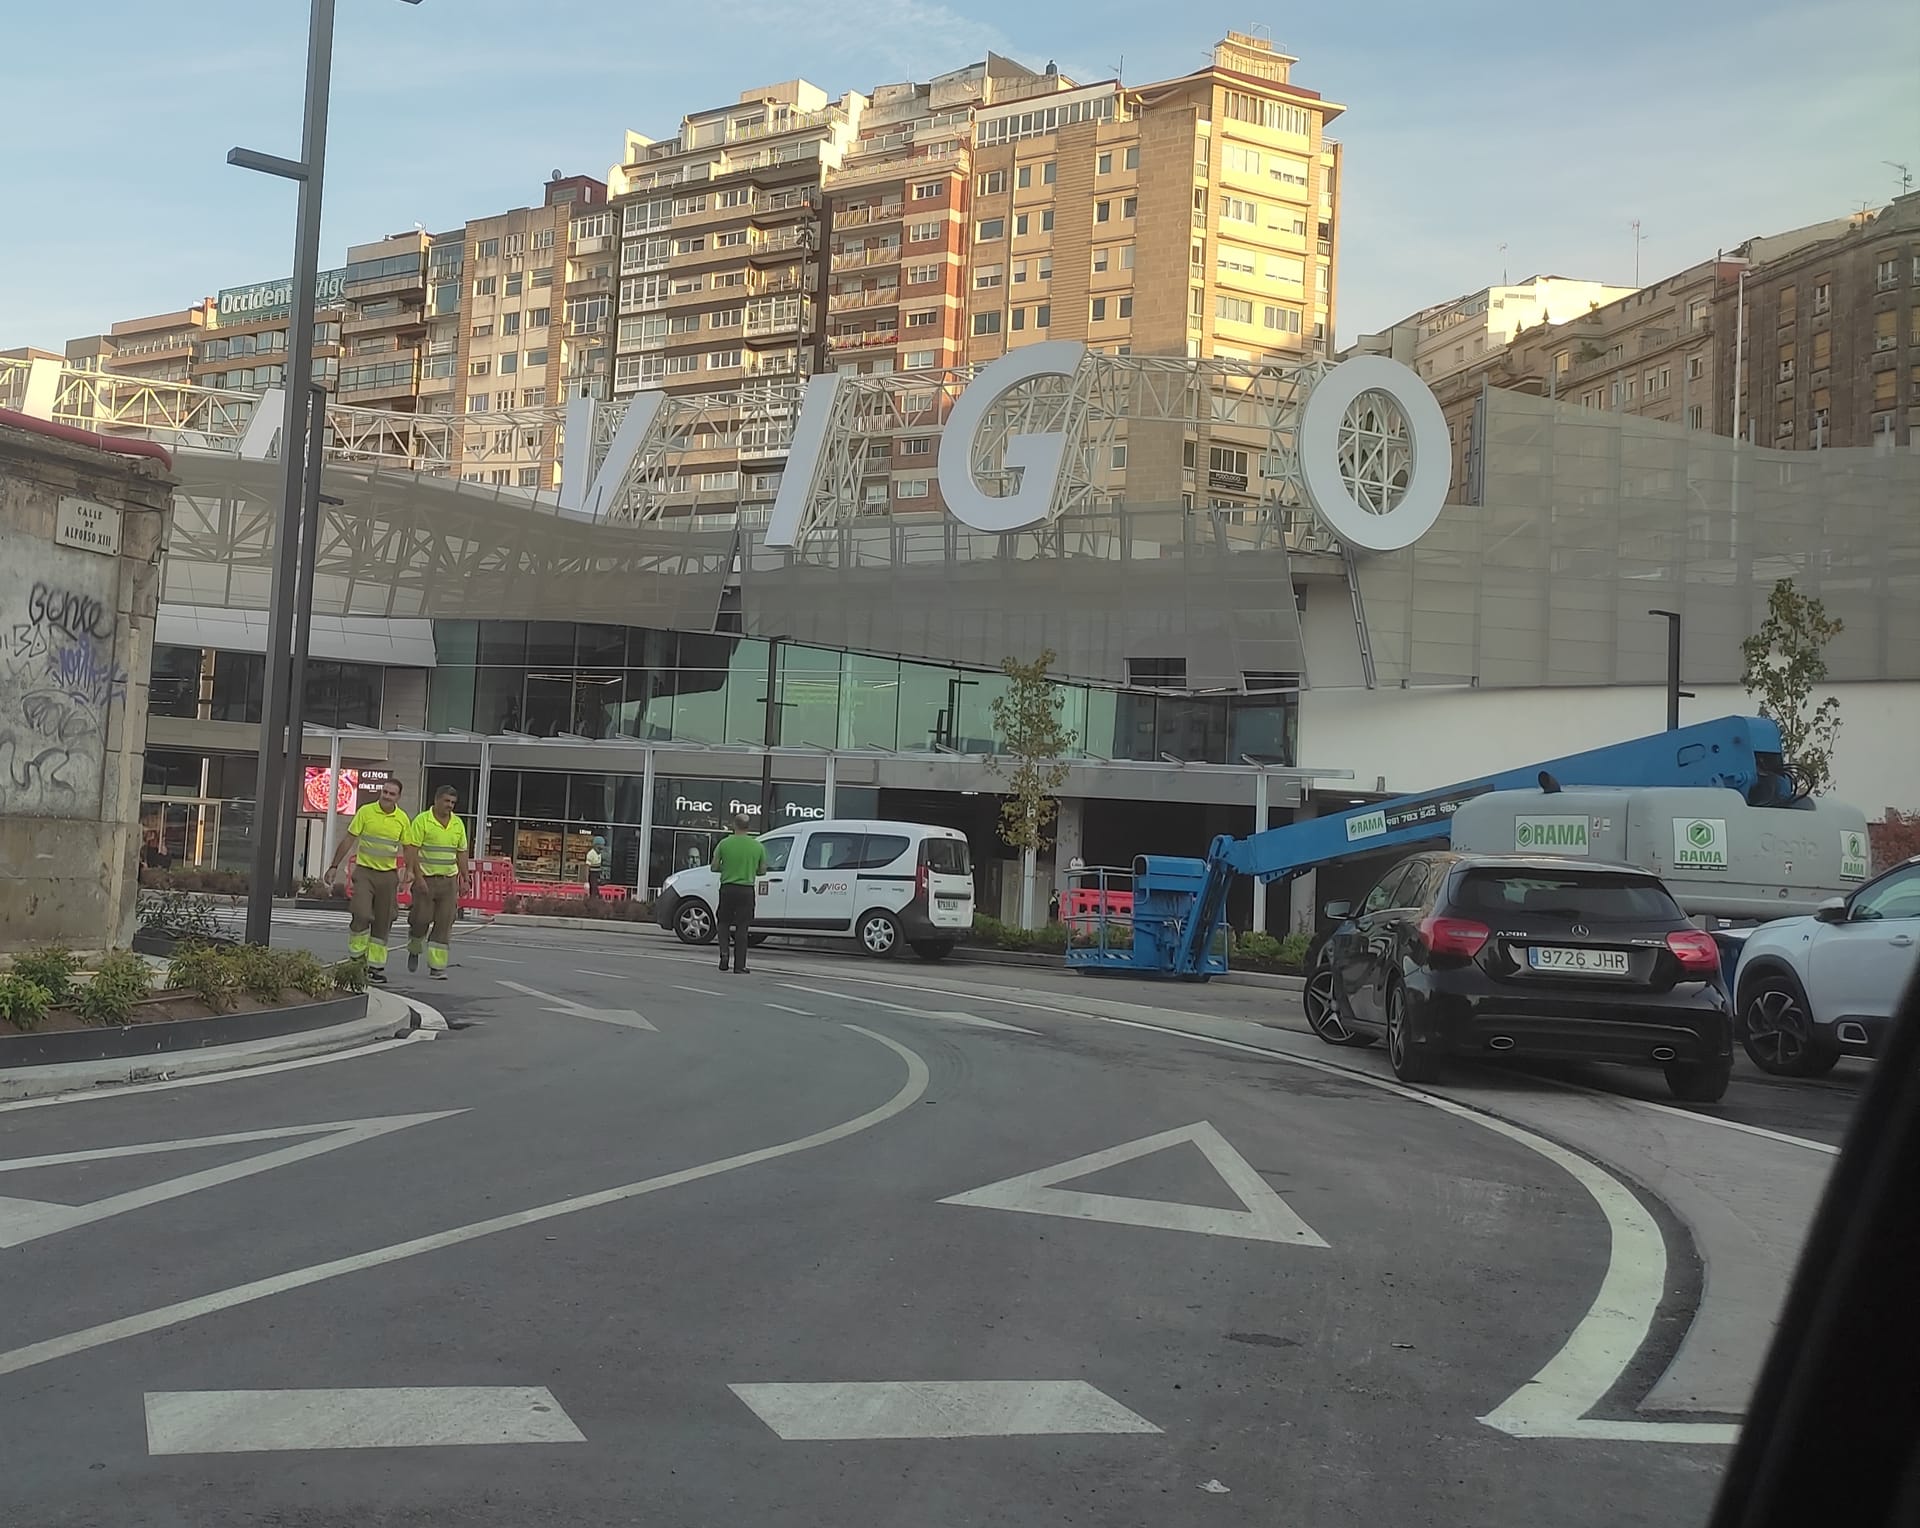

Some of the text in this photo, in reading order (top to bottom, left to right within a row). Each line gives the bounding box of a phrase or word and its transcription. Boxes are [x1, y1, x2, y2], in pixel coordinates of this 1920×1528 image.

[559, 340, 1452, 551] VIGO
[77, 506, 103, 520] CALLE
[84, 520, 94, 529] DE
[65, 526, 111, 546] ALFONSO XIII
[361, 771, 388, 779] GINOS
[675, 796, 713, 812] fnac
[785, 802, 825, 819] fnac
[1419, 808, 1437, 819] 542
[1440, 804, 1457, 814] 986
[1357, 816, 1384, 833] RAMA
[1534, 824, 1587, 845] RAMA
[1679, 850, 1722, 863] RAMA
[1843, 862, 1864, 875] RAMA
[827, 883, 848, 891] VIGO
[1542, 950, 1625, 968] 9726 JHR
